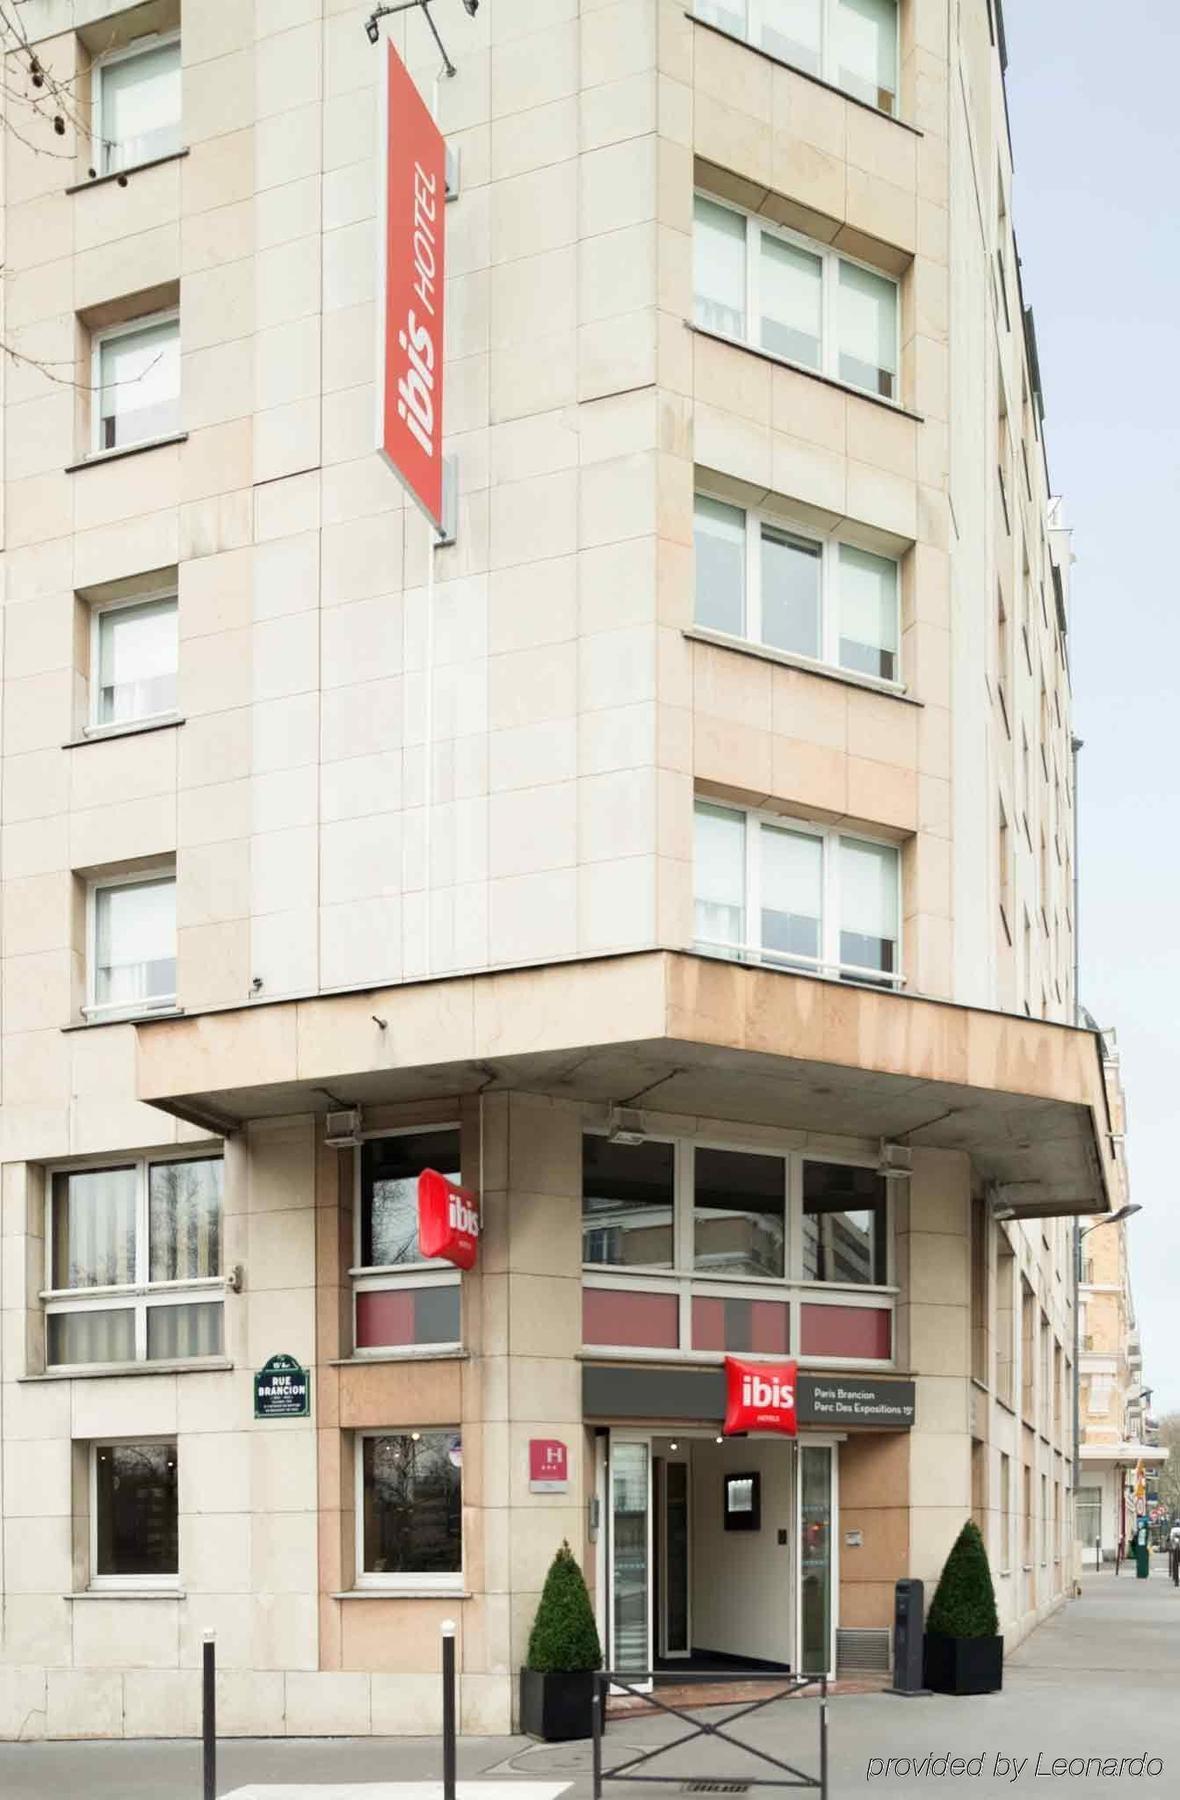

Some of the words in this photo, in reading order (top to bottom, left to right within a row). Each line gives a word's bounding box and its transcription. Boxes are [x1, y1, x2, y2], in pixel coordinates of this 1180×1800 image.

[414, 161, 436, 316] HOTEL
[398, 309, 434, 457] ibis
[449, 1193, 479, 1237] ibis
[272, 1376, 291, 1386] RUE
[258, 1385, 305, 1396] BRANCION
[743, 1375, 794, 1409] ibis
[814, 1387, 836, 1398] Paris
[837, 1389, 875, 1399] Brancion
[814, 1401, 834, 1411] Parc
[836, 1402, 852, 1412] Des
[854, 1402, 901, 1415] Expositions
[547, 1448, 562, 1463] H
